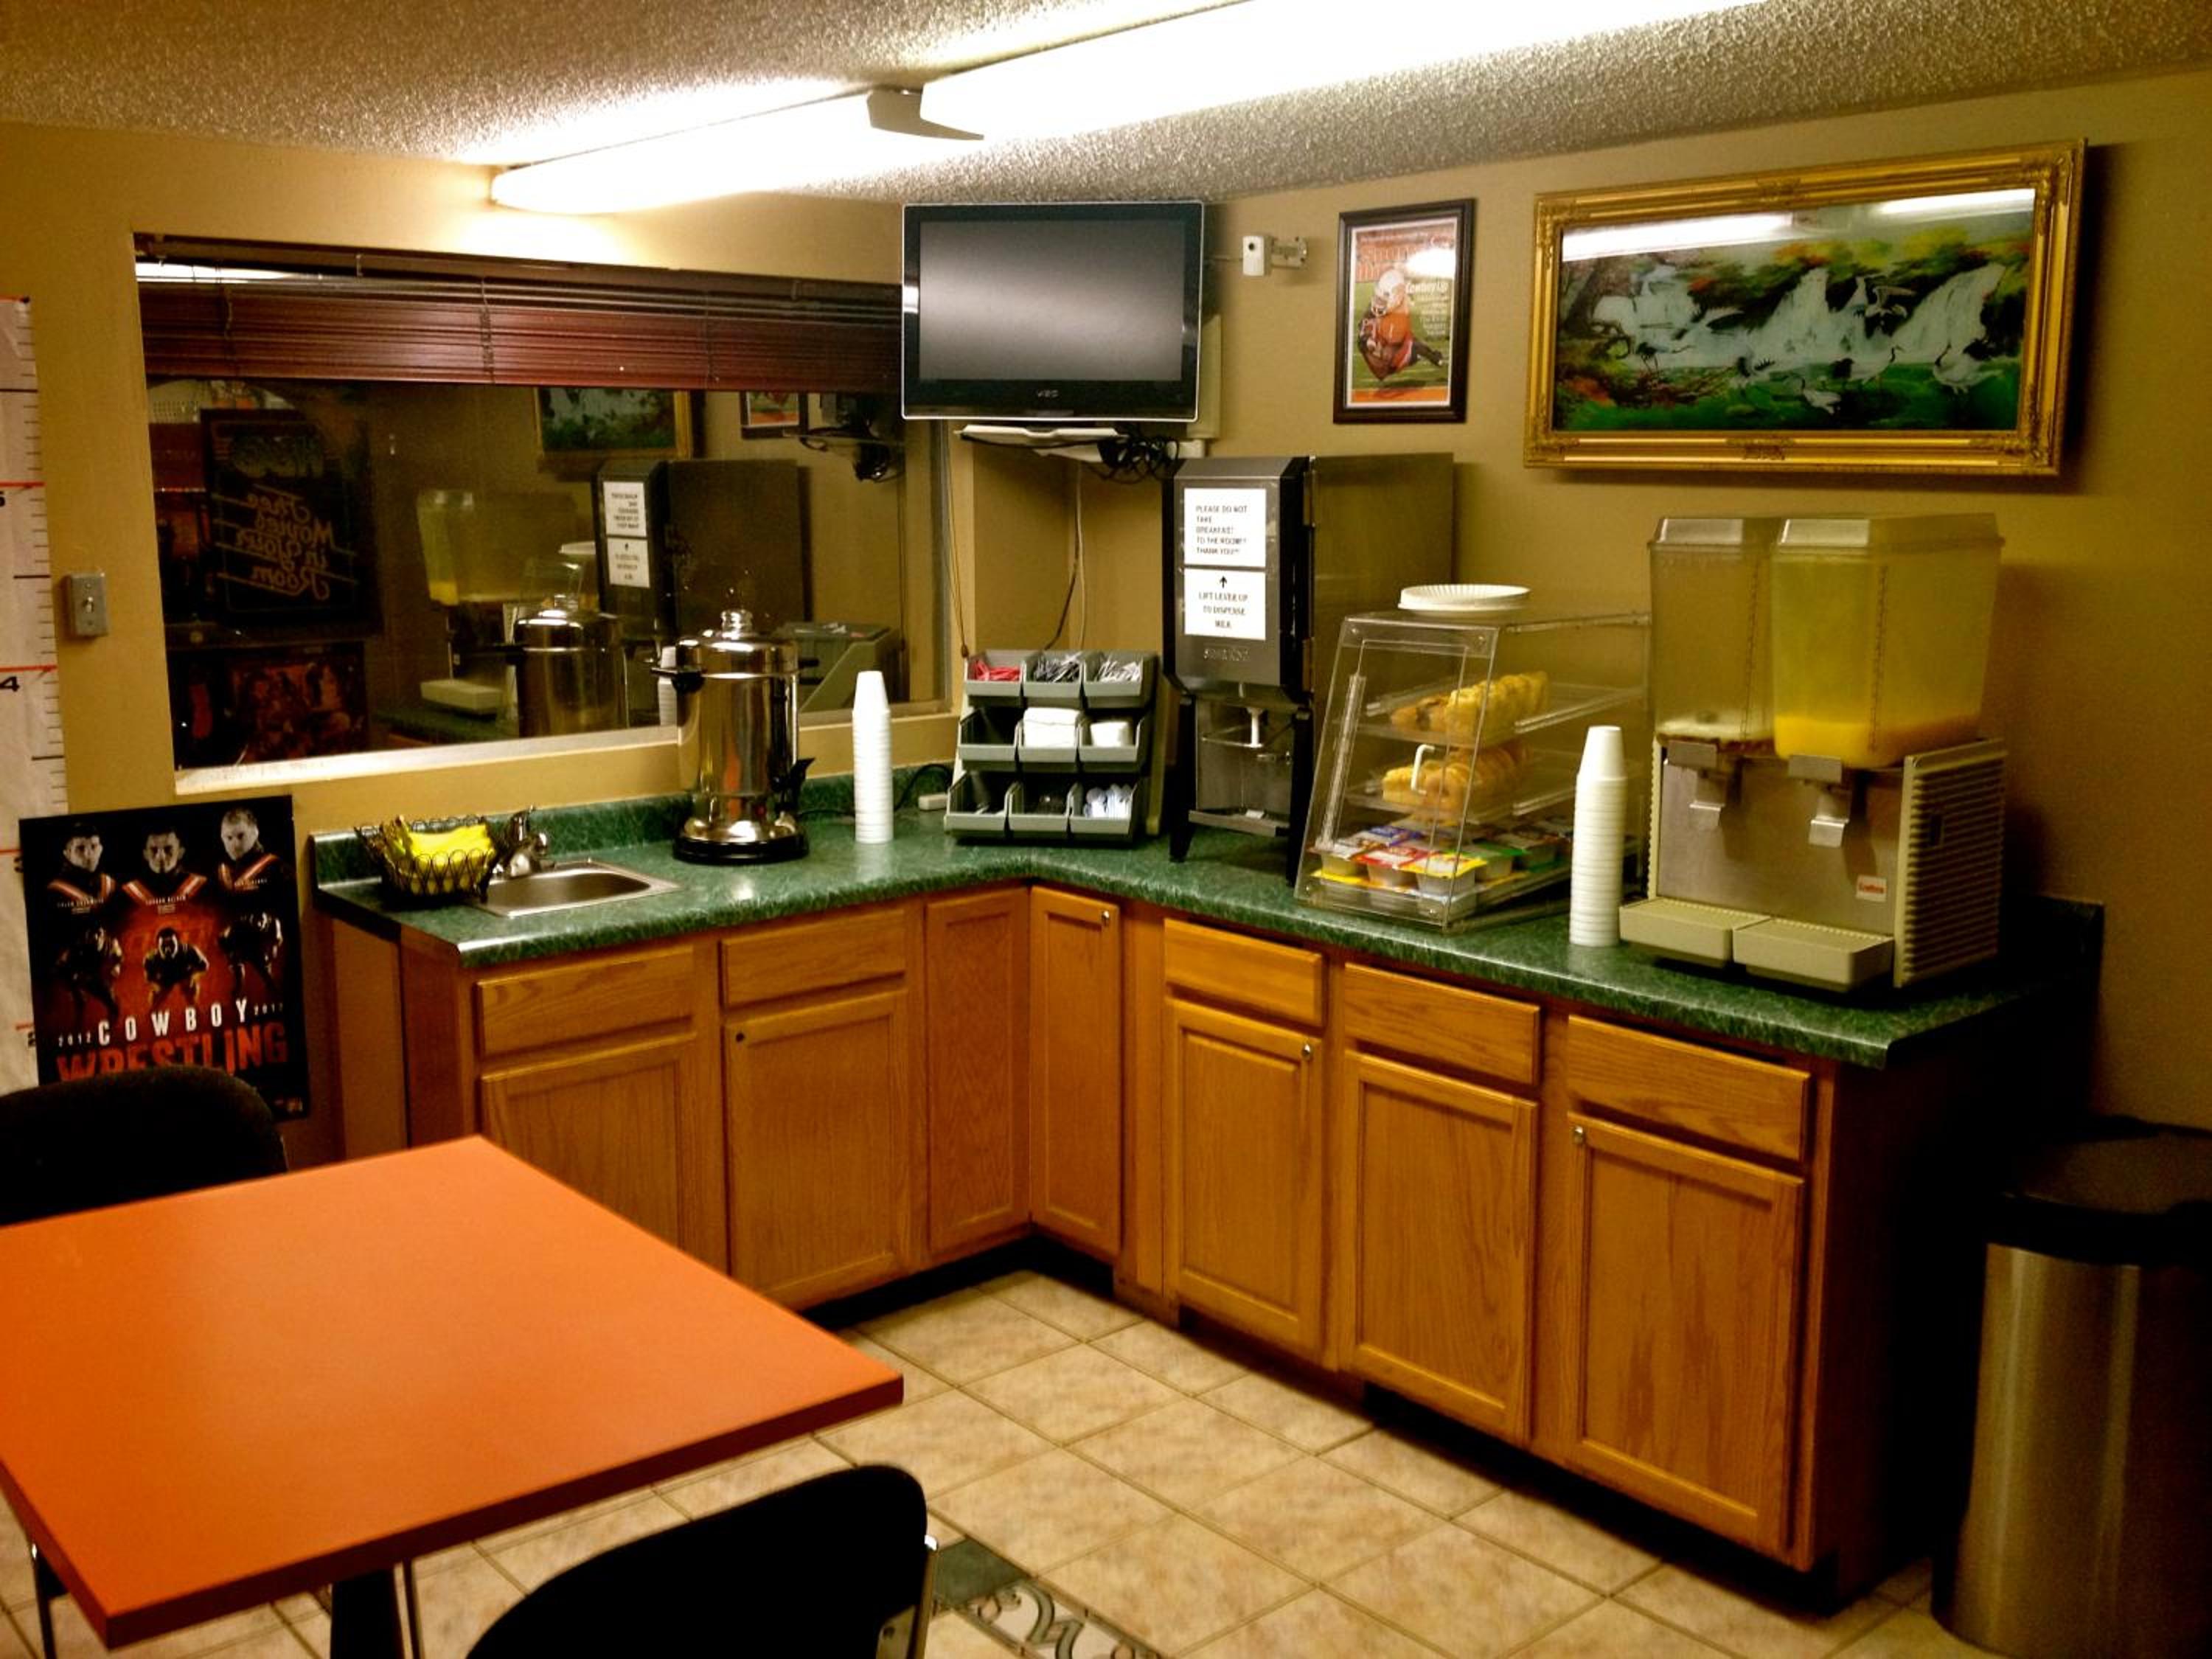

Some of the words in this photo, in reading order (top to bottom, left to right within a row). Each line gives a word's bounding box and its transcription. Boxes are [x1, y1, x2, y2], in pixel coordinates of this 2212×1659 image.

[1196, 505, 1220, 513] PLEASE
[1222, 505, 1232, 513] DO
[1234, 505, 1248, 514] NOT
[1196, 546, 1218, 555] THANK
[0, 675, 20, 692] 4
[98, 998, 248, 1046] COWBOY
[56, 1021, 289, 1082] WRESTLING
